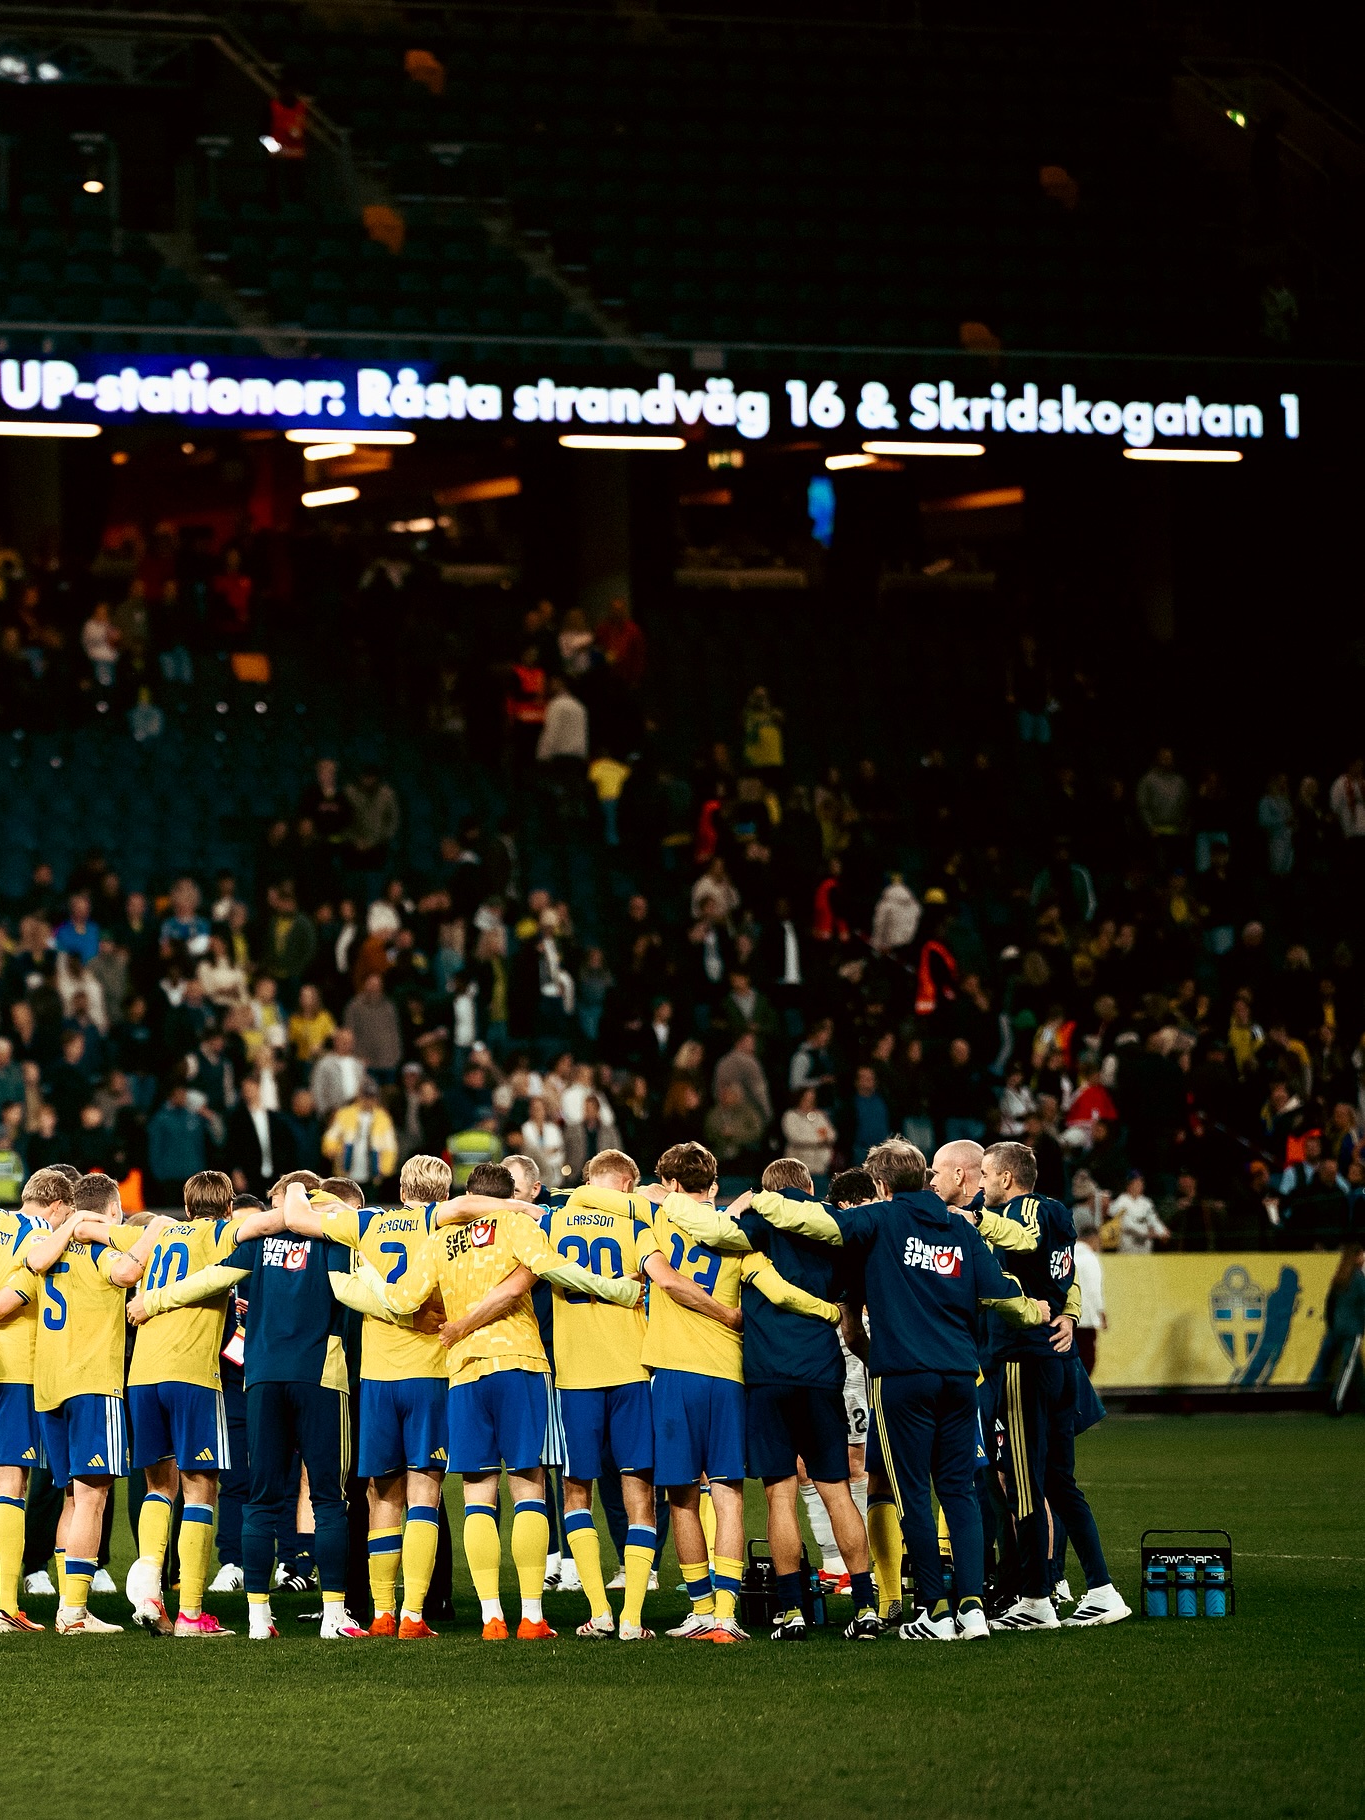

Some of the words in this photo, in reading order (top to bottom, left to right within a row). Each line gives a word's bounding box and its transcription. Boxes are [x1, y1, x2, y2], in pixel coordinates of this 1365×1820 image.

[0, 358, 346, 418] UP-stationer:
[357, 366, 502, 422] Råsta
[512, 372, 771, 440] strandväg
[785, 379, 845, 429] 16
[856, 381, 899, 430] &
[909, 381, 1264, 449] Skridskogatan
[1280, 392, 1299, 439] 1
[566, 1214, 615, 1228] LARSSON
[146, 1242, 190, 1291] 10
[380, 1241, 407, 1284] 7
[903, 1251, 936, 1272] SPEL
[43, 1261, 70, 1331] 5
